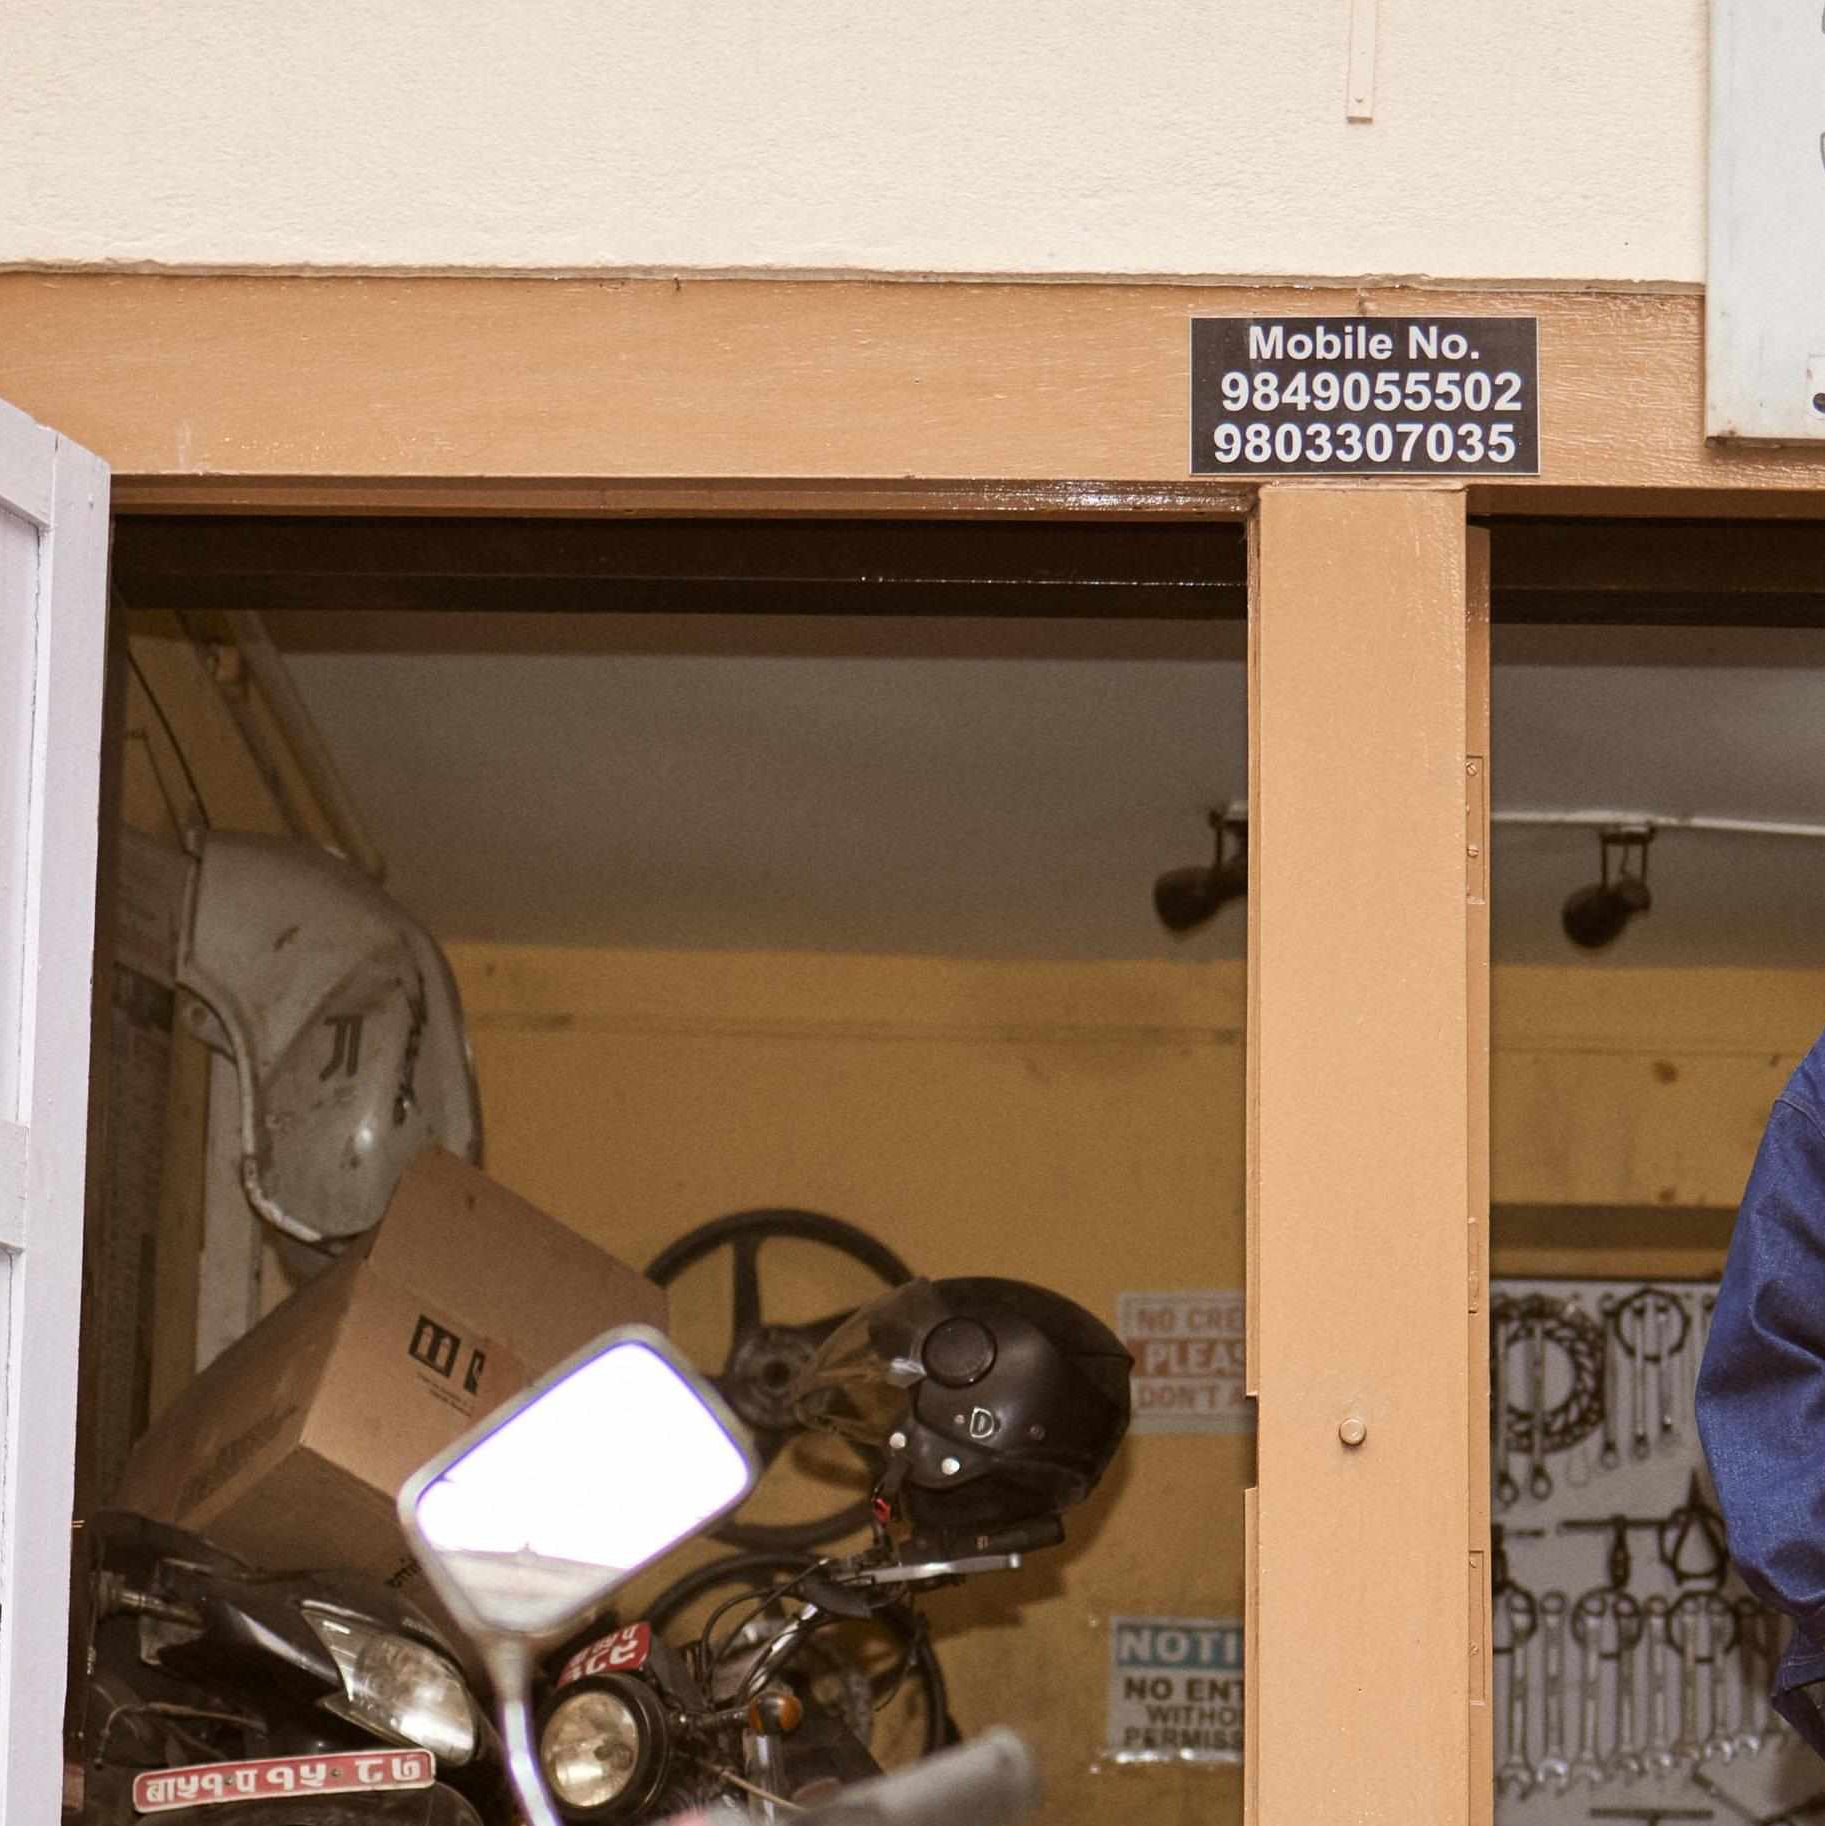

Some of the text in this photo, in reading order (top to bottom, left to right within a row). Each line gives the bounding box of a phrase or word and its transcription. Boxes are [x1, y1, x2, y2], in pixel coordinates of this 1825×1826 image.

[1247, 325, 1481, 362] Mobile No.
[1221, 371, 1524, 414] 9849055502
[1213, 422, 1516, 466] 9803307035
[1125, 1677, 1174, 1701] NO
